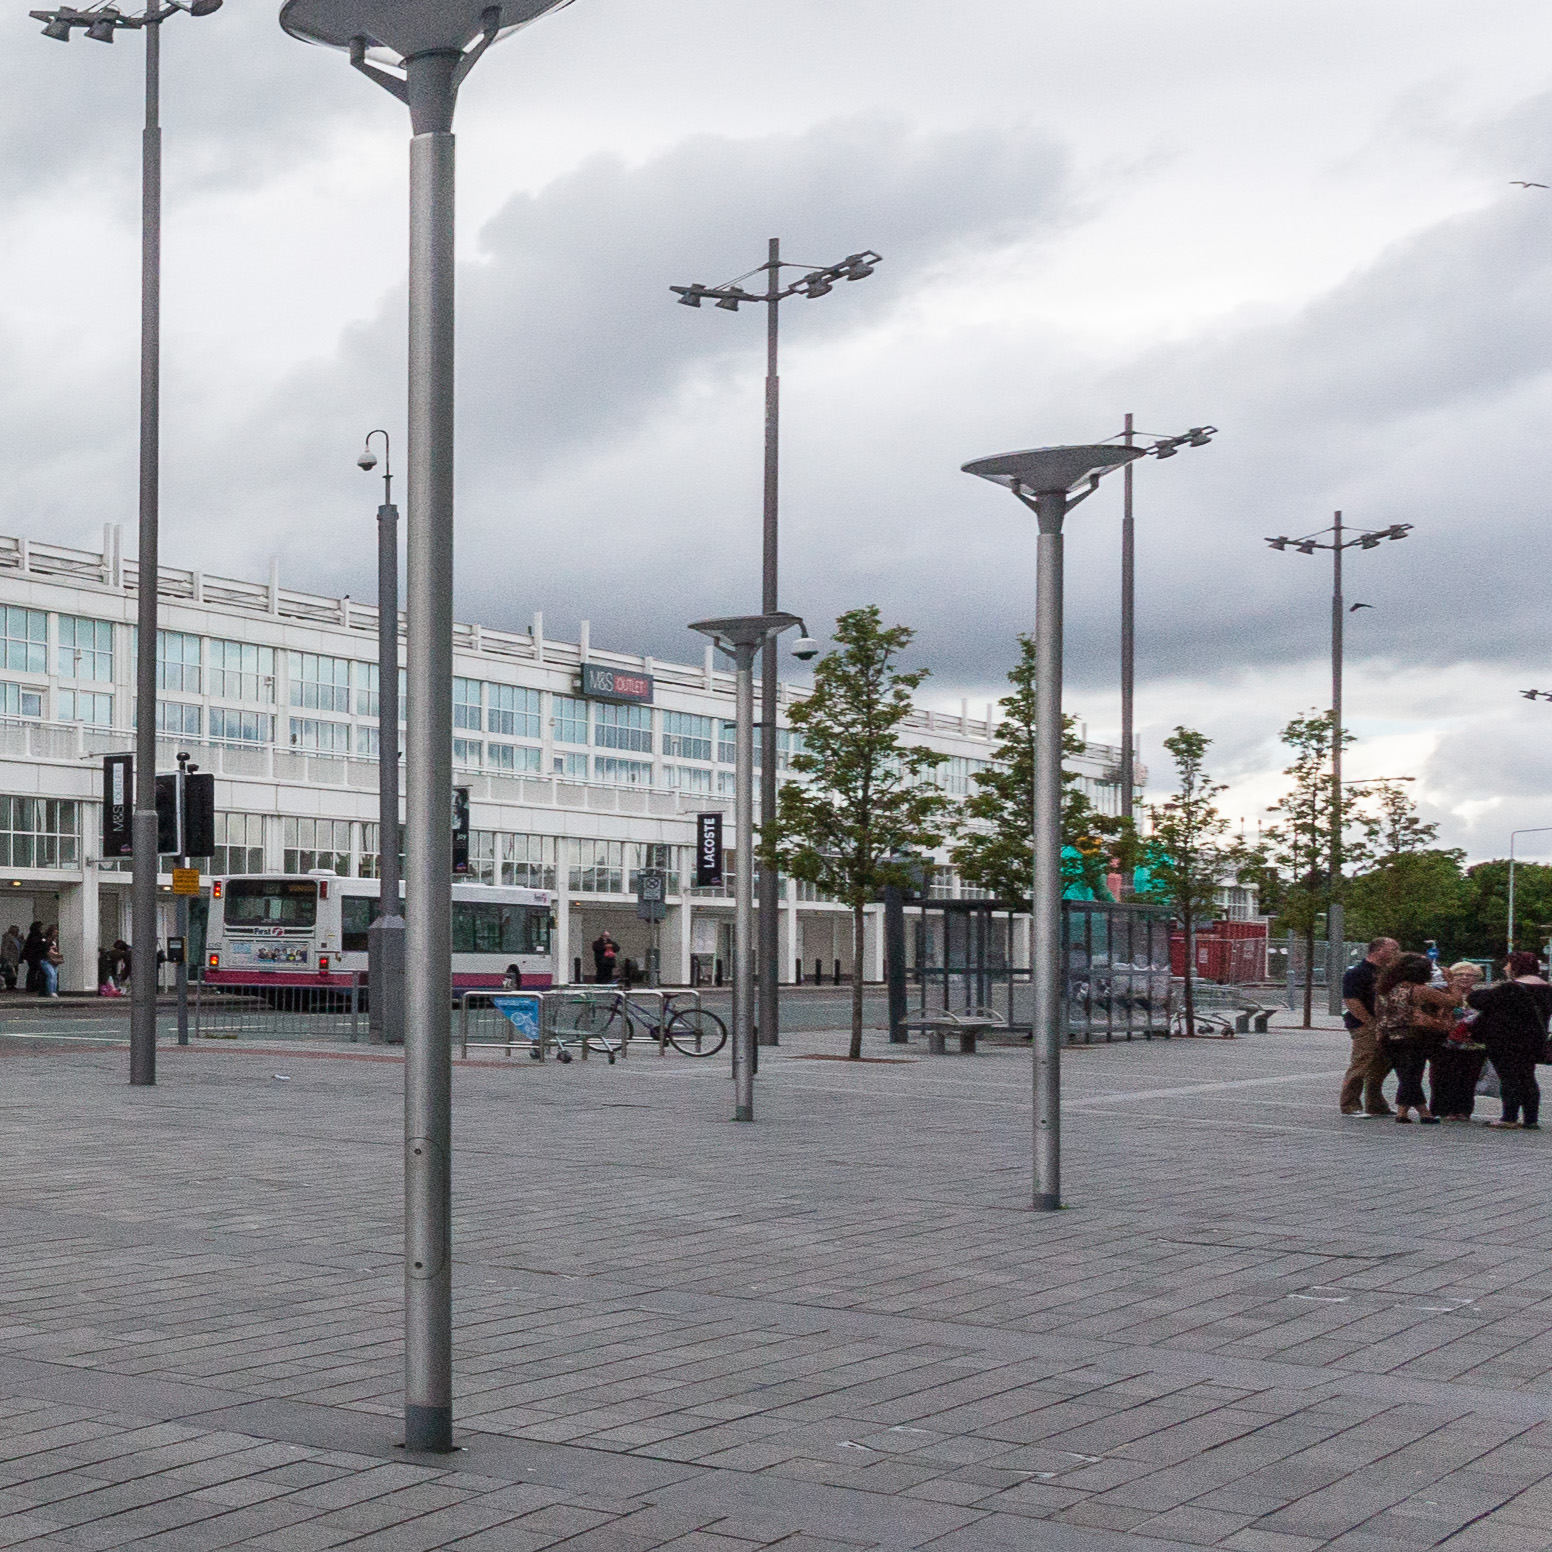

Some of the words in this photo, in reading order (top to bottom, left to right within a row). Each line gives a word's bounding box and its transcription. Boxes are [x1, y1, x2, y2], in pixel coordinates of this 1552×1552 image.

[589, 670, 614, 692] M&S
[616, 676, 645, 694] OUTLET
[113, 765, 124, 802] OUTLET
[112, 805, 125, 832] M&S
[703, 817, 716, 868] LACOSTE
